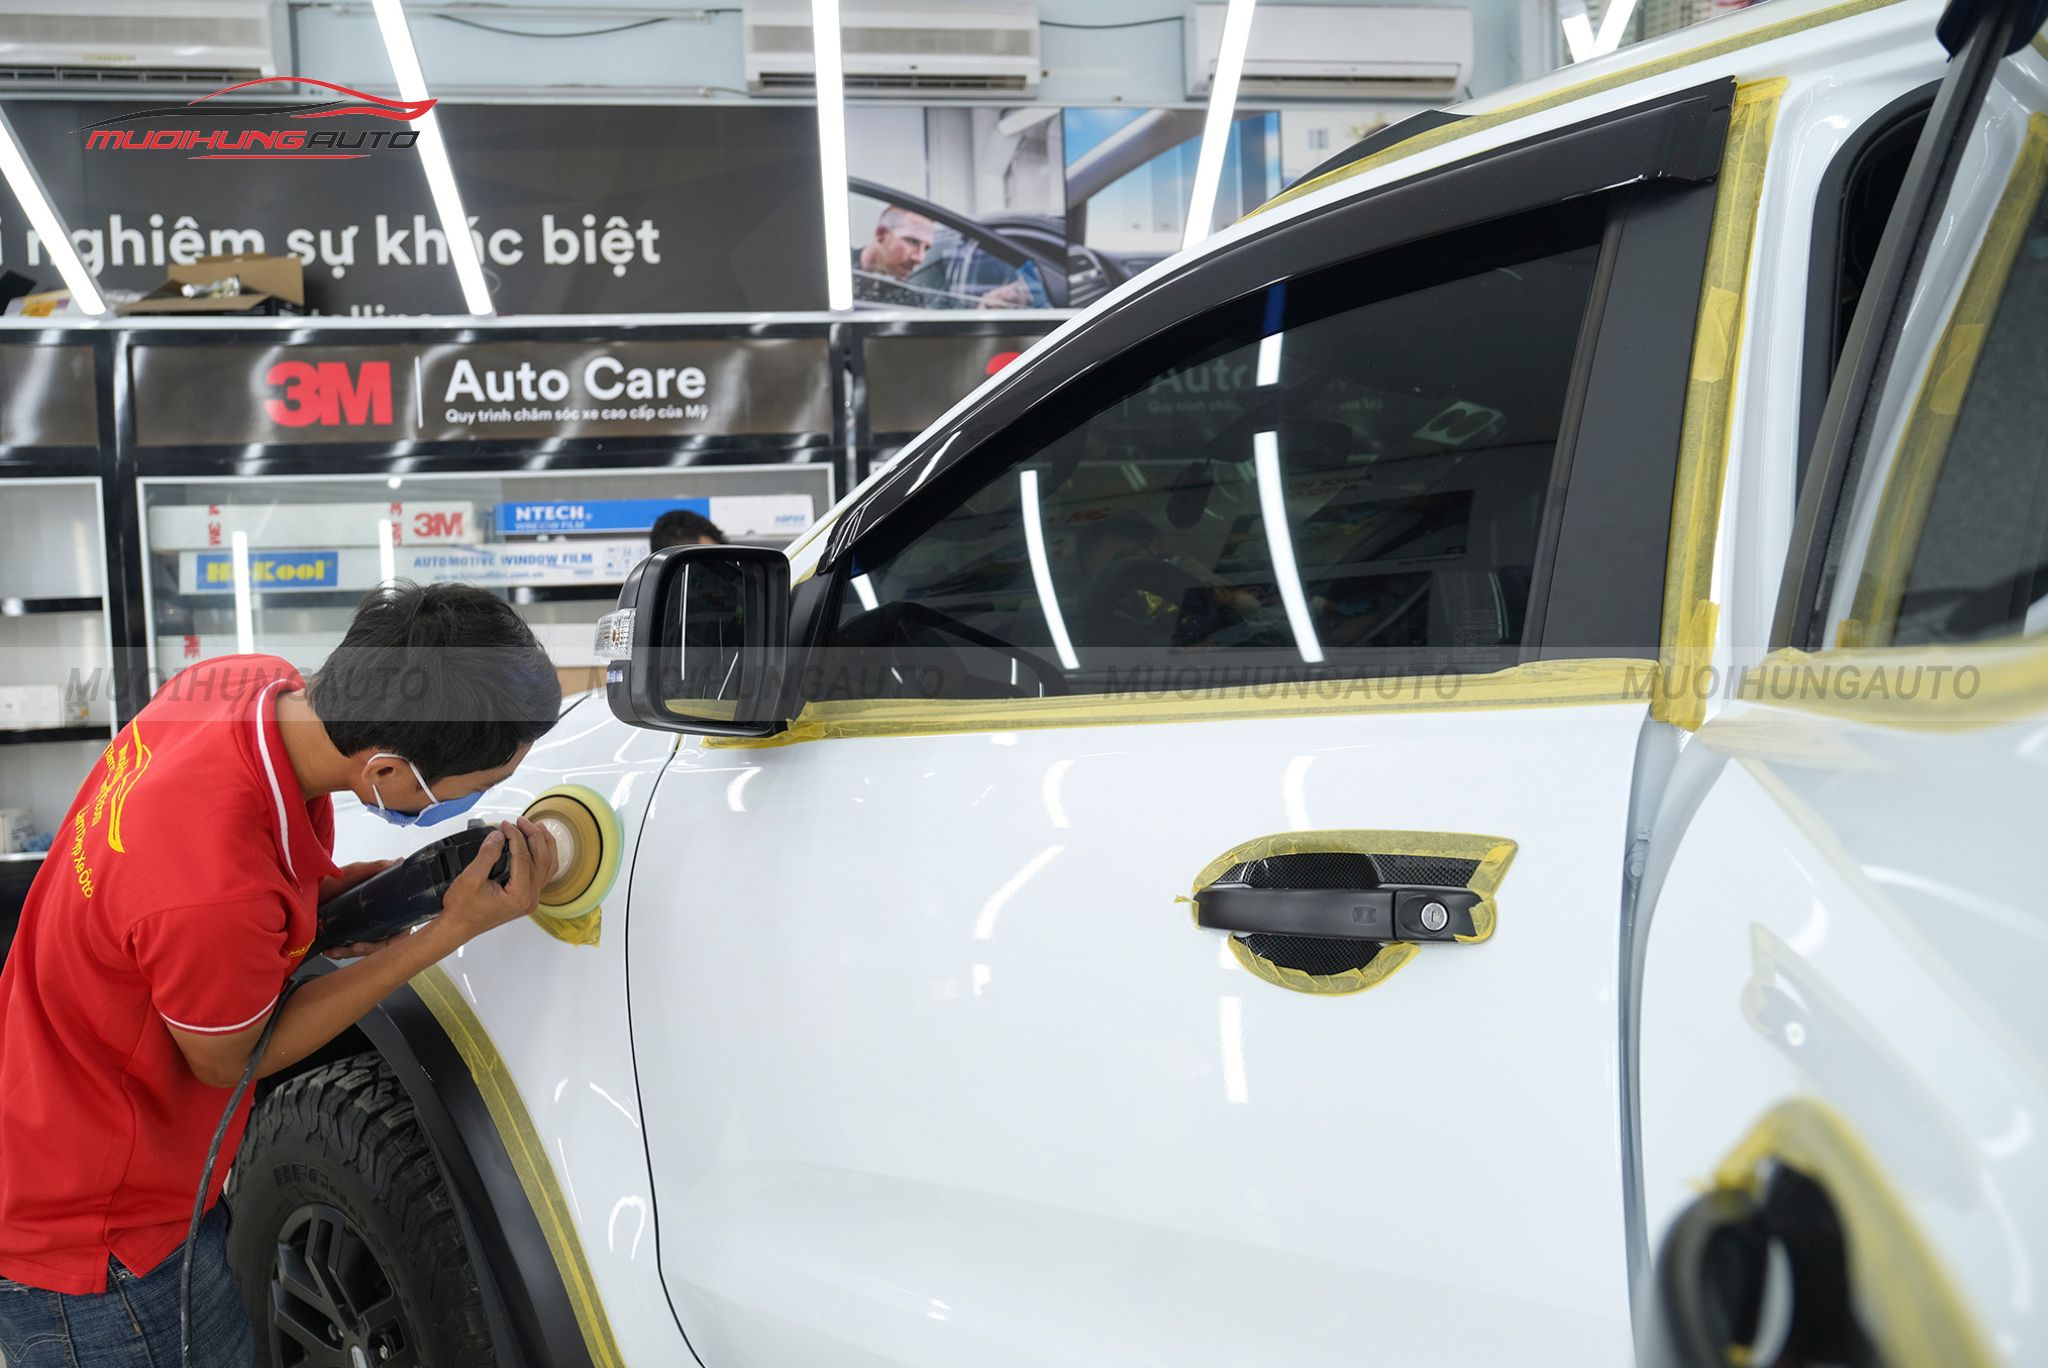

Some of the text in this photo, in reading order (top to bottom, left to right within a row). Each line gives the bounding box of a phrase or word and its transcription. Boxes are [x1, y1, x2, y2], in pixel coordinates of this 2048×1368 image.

[542, 213, 661, 278] biệt
[265, 360, 394, 428] 3M
[444, 356, 707, 403] Auto Care
[445, 403, 709, 425] Quy trình chăm sóc xe cao cấp của Mỹ
[413, 512, 462, 537] 3M
[414, 556, 495, 568] AUTOMOTIVE
[501, 555, 559, 567] WINDOW
[562, 552, 593, 564] FILM
